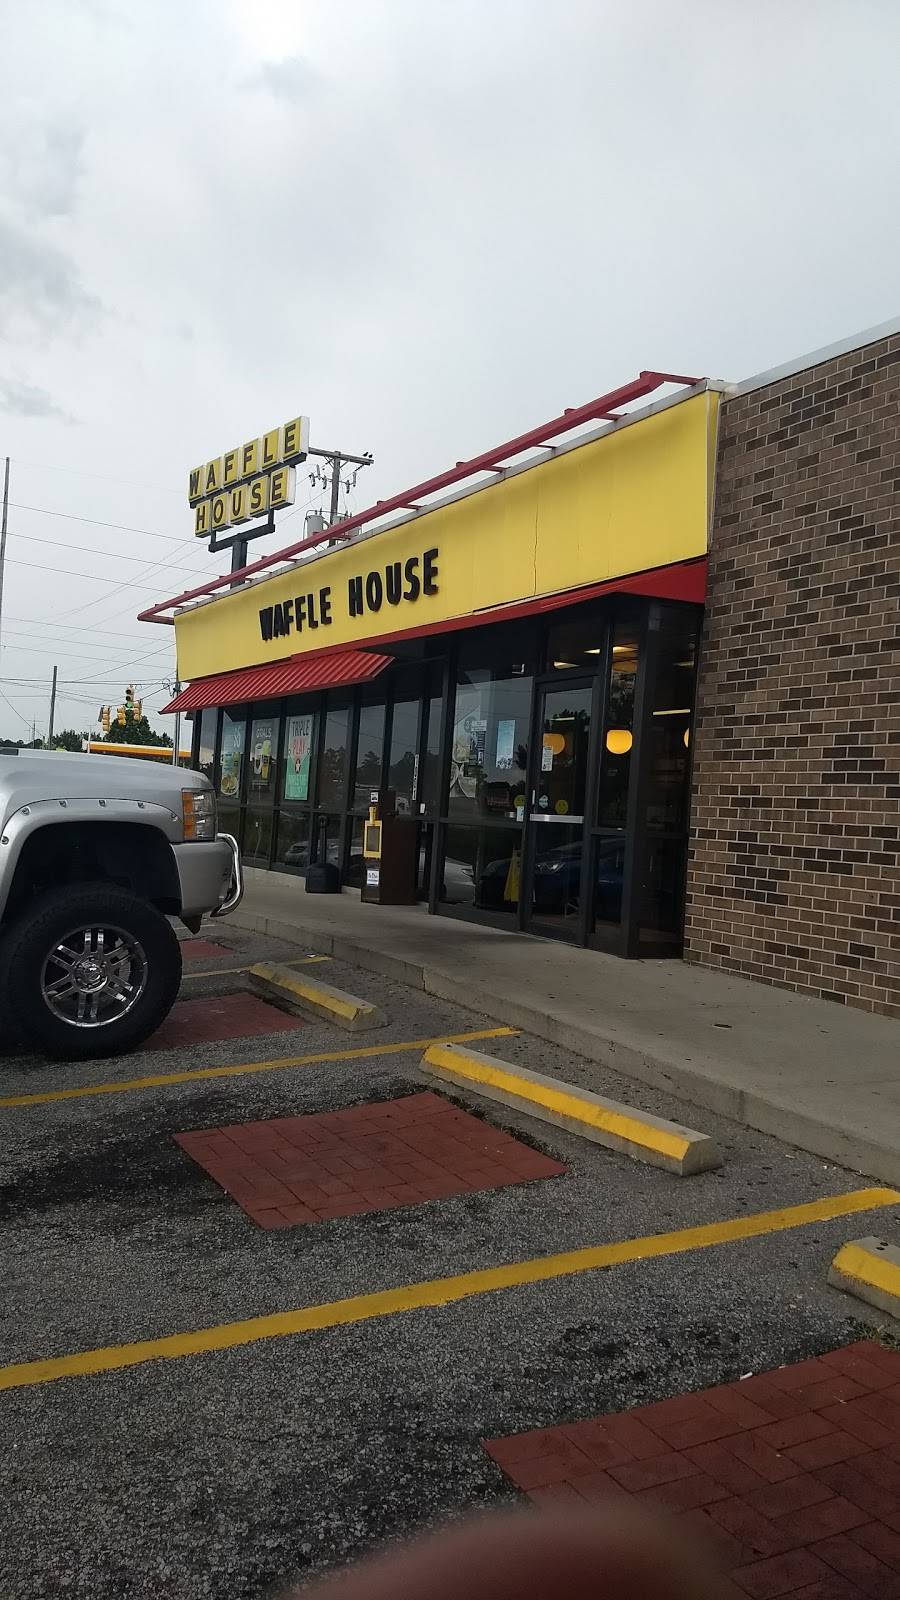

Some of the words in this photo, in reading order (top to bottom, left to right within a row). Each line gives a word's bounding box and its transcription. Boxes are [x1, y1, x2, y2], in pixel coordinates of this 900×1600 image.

[188, 423, 296, 497] WAFFLE
[195, 472, 284, 531] HOUSE
[259, 586, 332, 641] WAFFLE
[348, 548, 439, 617] HOUSE
[293, 720, 310, 736] TRIPLE
